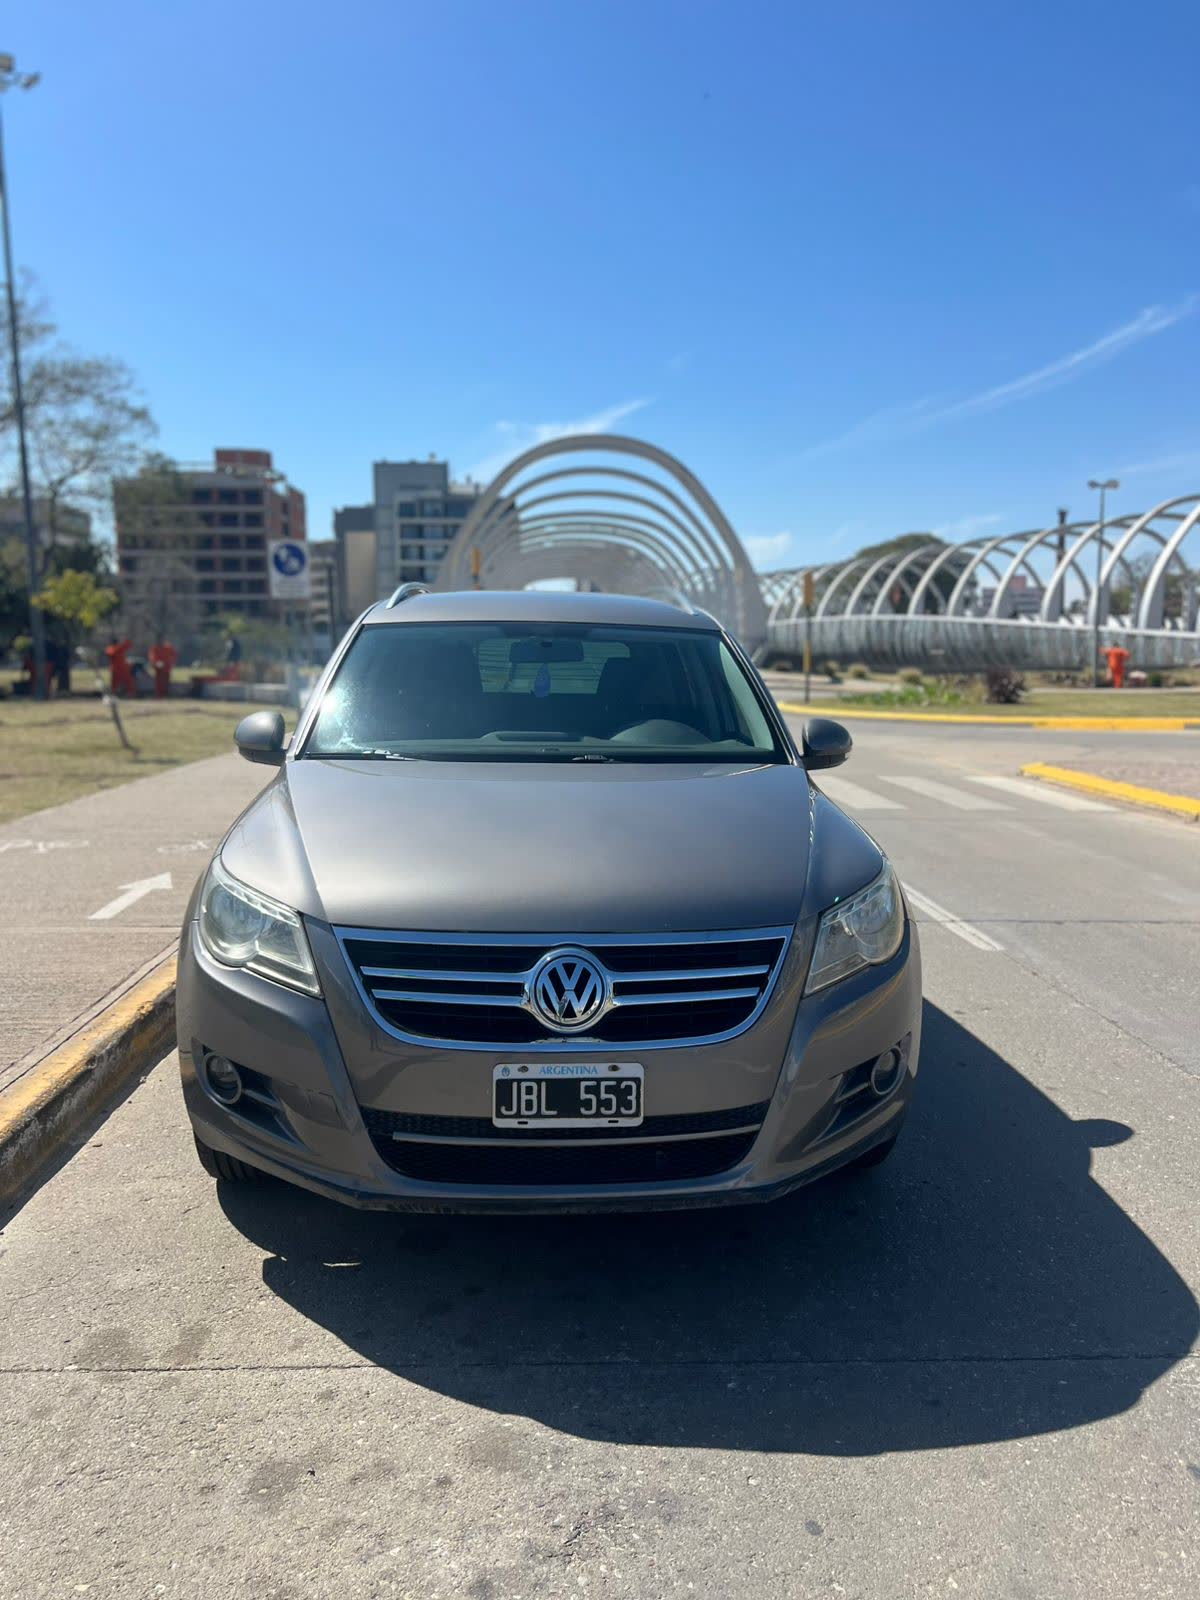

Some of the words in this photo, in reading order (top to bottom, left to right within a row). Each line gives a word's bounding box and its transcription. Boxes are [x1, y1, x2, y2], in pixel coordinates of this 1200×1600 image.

[539, 1065, 598, 1075] ARGENTINA
[500, 1081, 558, 1116] JBL
[579, 1081, 637, 1115] 553
